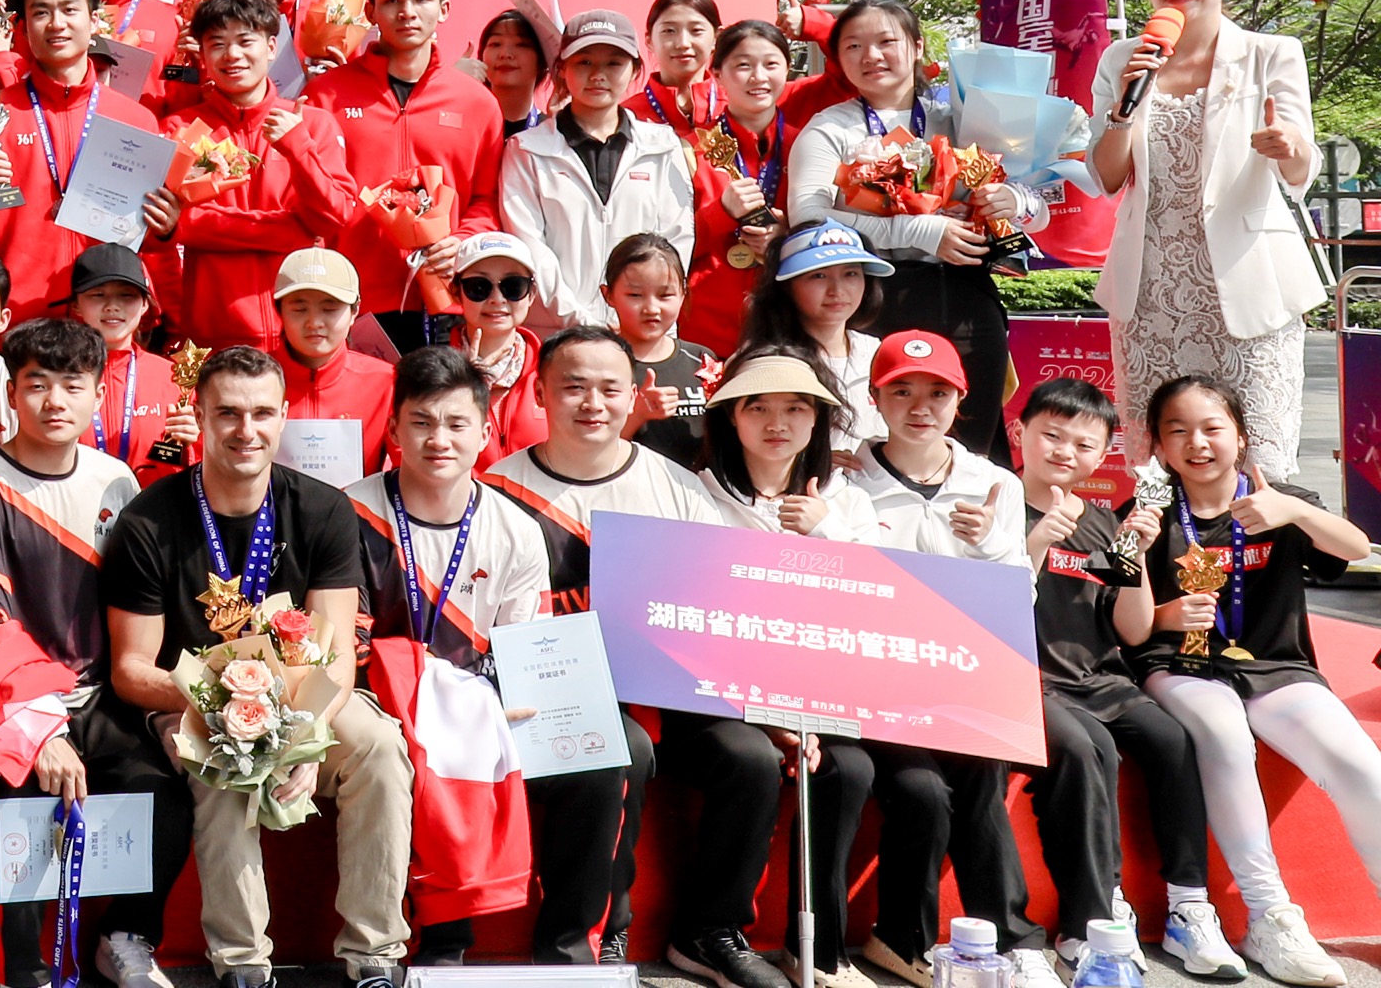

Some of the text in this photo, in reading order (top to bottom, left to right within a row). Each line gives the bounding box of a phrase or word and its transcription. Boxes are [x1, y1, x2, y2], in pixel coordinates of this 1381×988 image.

[199, 499, 217, 540] FEDERATION
[215, 554, 228, 574] CHINA
[401, 537, 415, 583] FEDERATION
[777, 548, 844, 577] 2024
[728, 563, 895, 599] 全国室内跳伞冠军赛
[646, 600, 980, 672] 湖南省航空运动管理中心
[538, 669, 567, 680] 获奖证书
[56, 917, 65, 947] SPORTS
